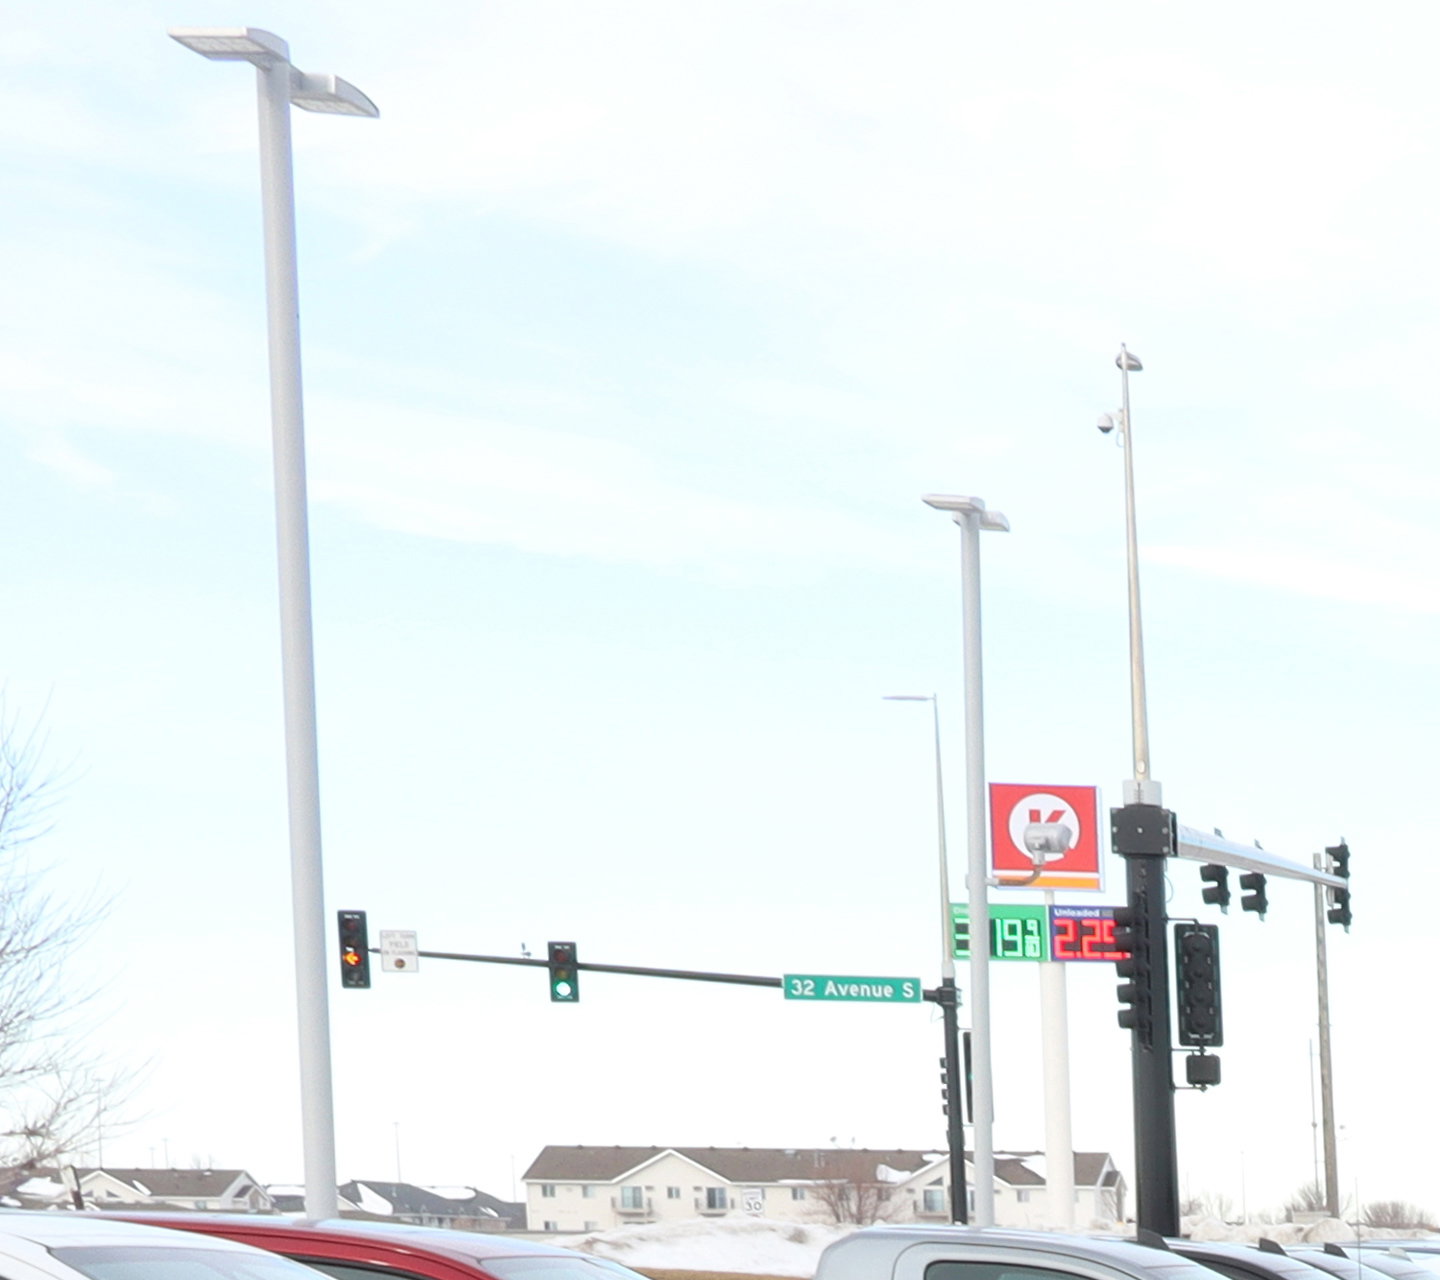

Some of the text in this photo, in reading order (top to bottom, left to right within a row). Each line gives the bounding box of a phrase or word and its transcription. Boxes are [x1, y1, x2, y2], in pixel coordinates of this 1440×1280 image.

[791, 979, 914, 998] 32 Avenue S
[745, 1201, 761, 1211] 30
